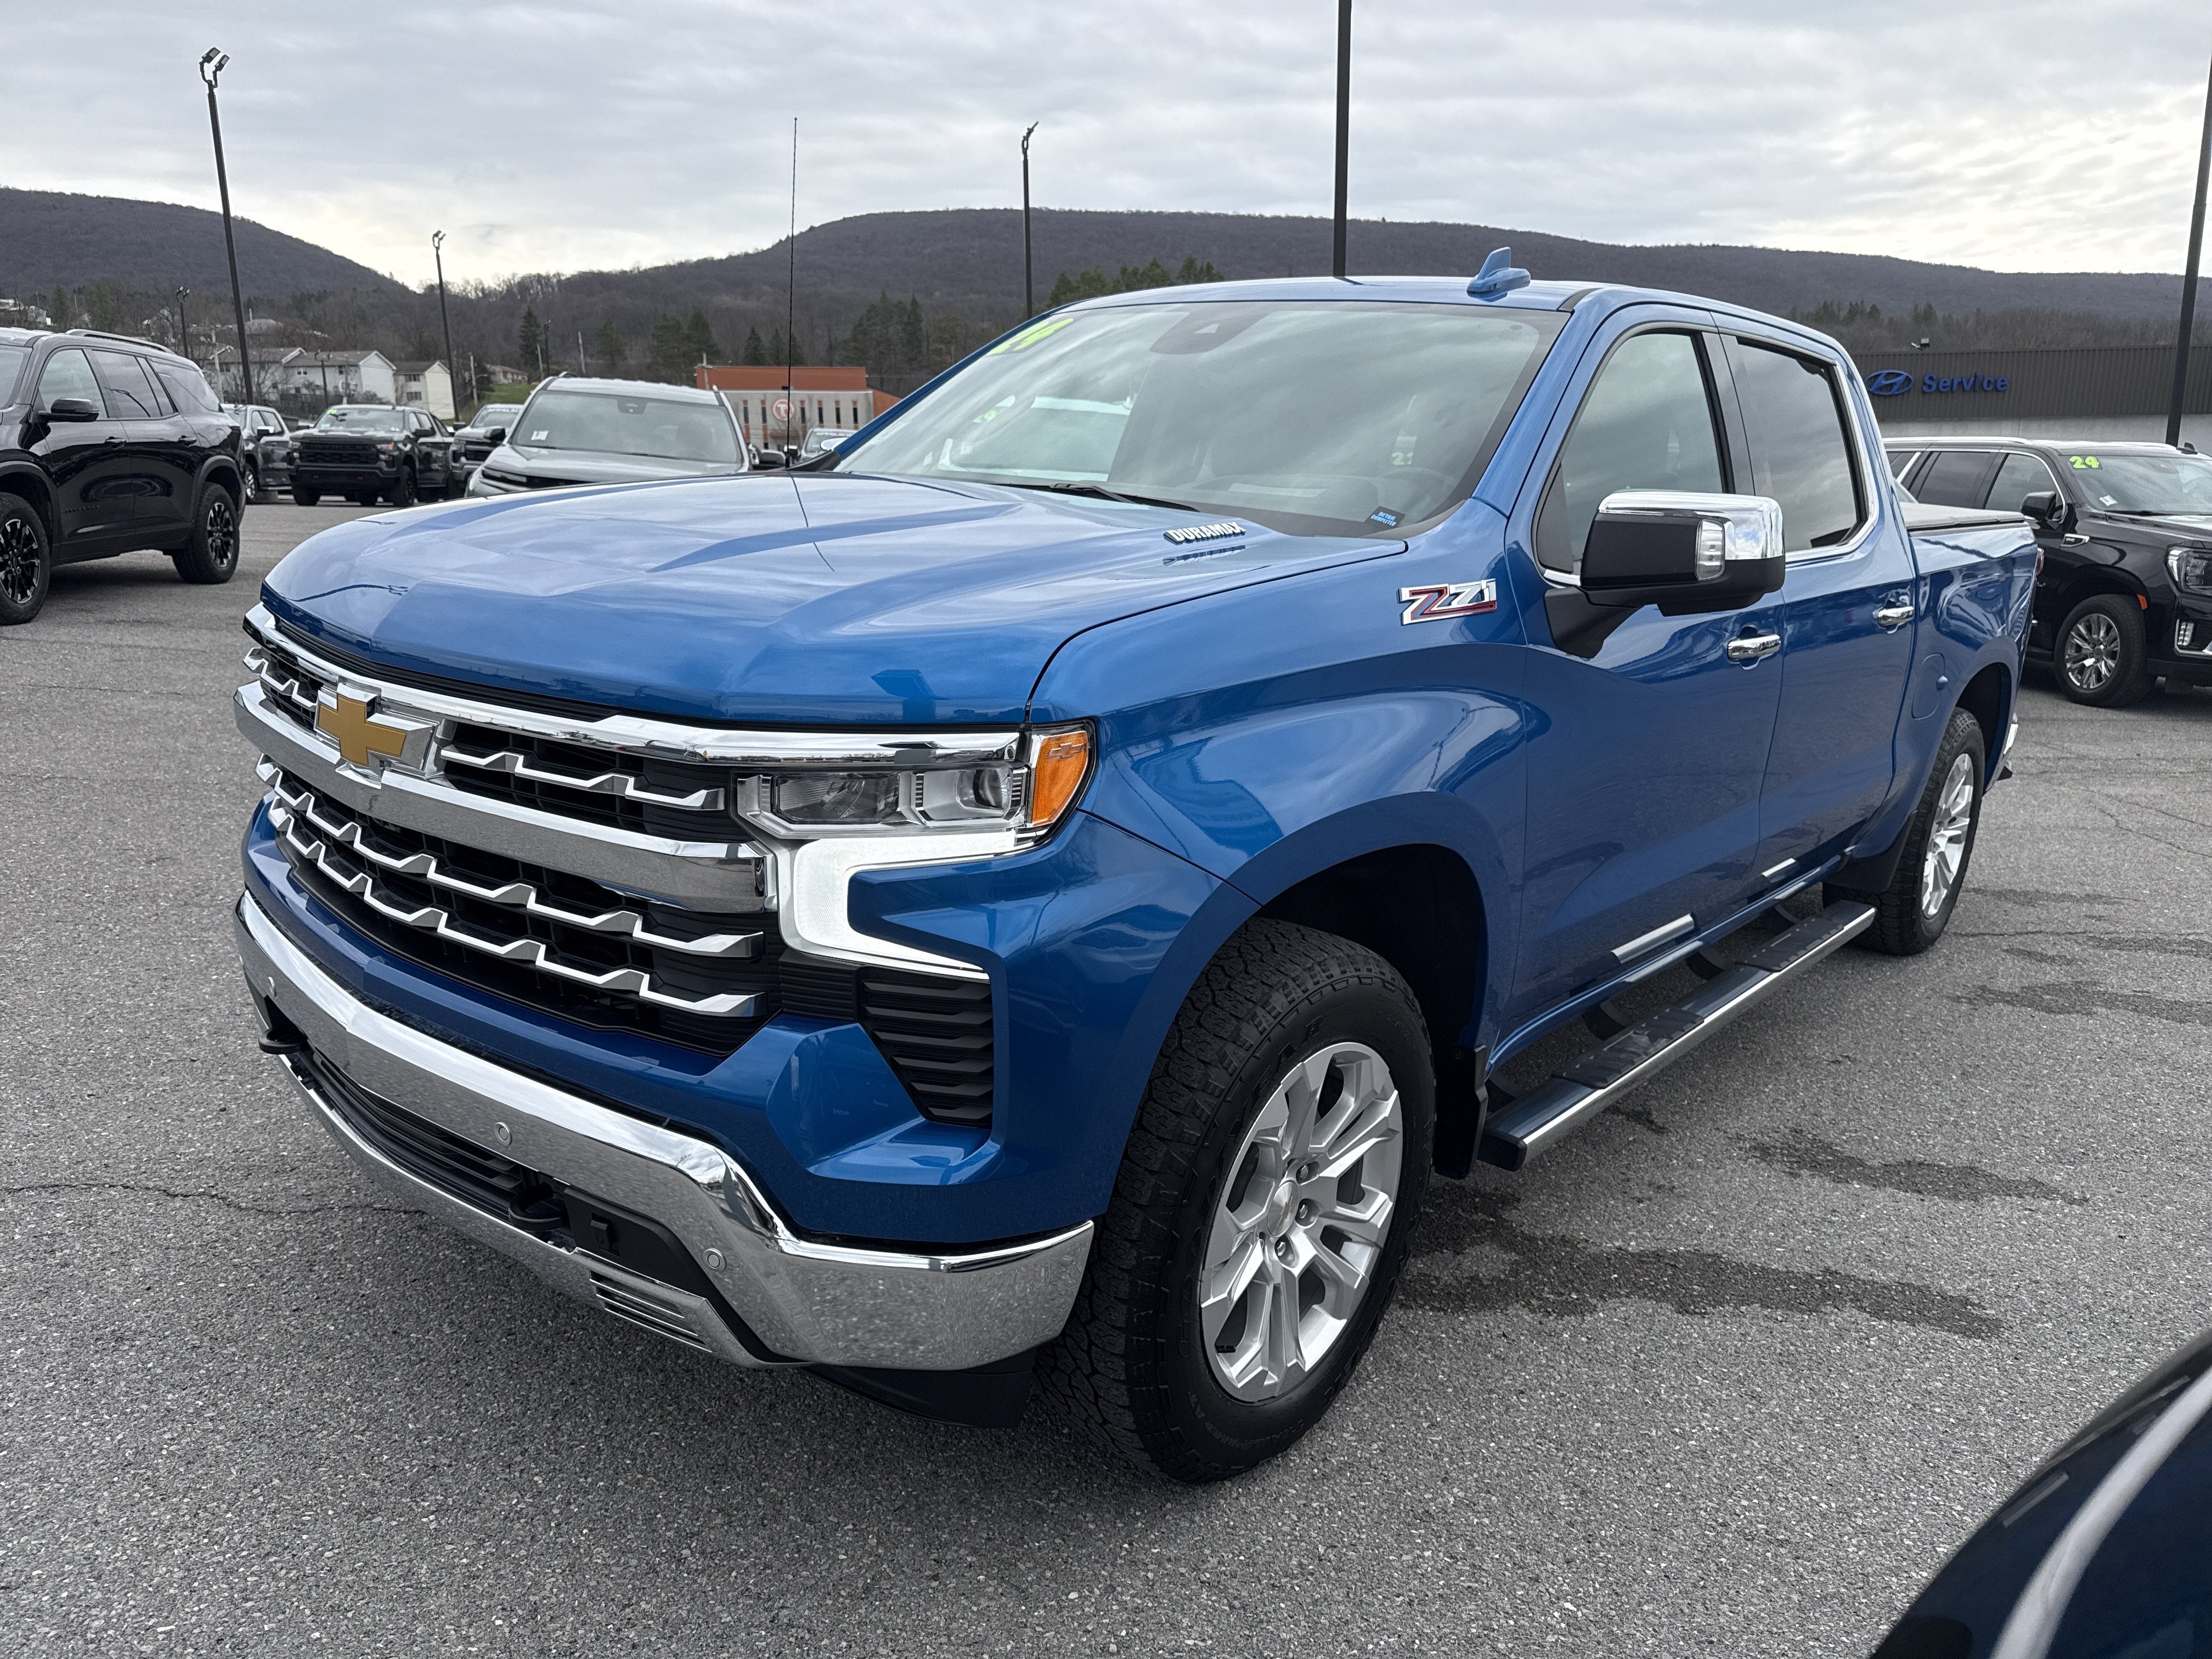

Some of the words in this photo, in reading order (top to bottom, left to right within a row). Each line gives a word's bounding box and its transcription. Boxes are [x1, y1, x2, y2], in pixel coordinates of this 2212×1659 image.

[1922, 372, 2010, 393] Service
[1370, 515, 1397, 527] COMPLETED
[1378, 511, 1396, 521] DETAIL
[1165, 522, 1246, 544] DURAMAX
[1400, 578, 1497, 625] Z71
